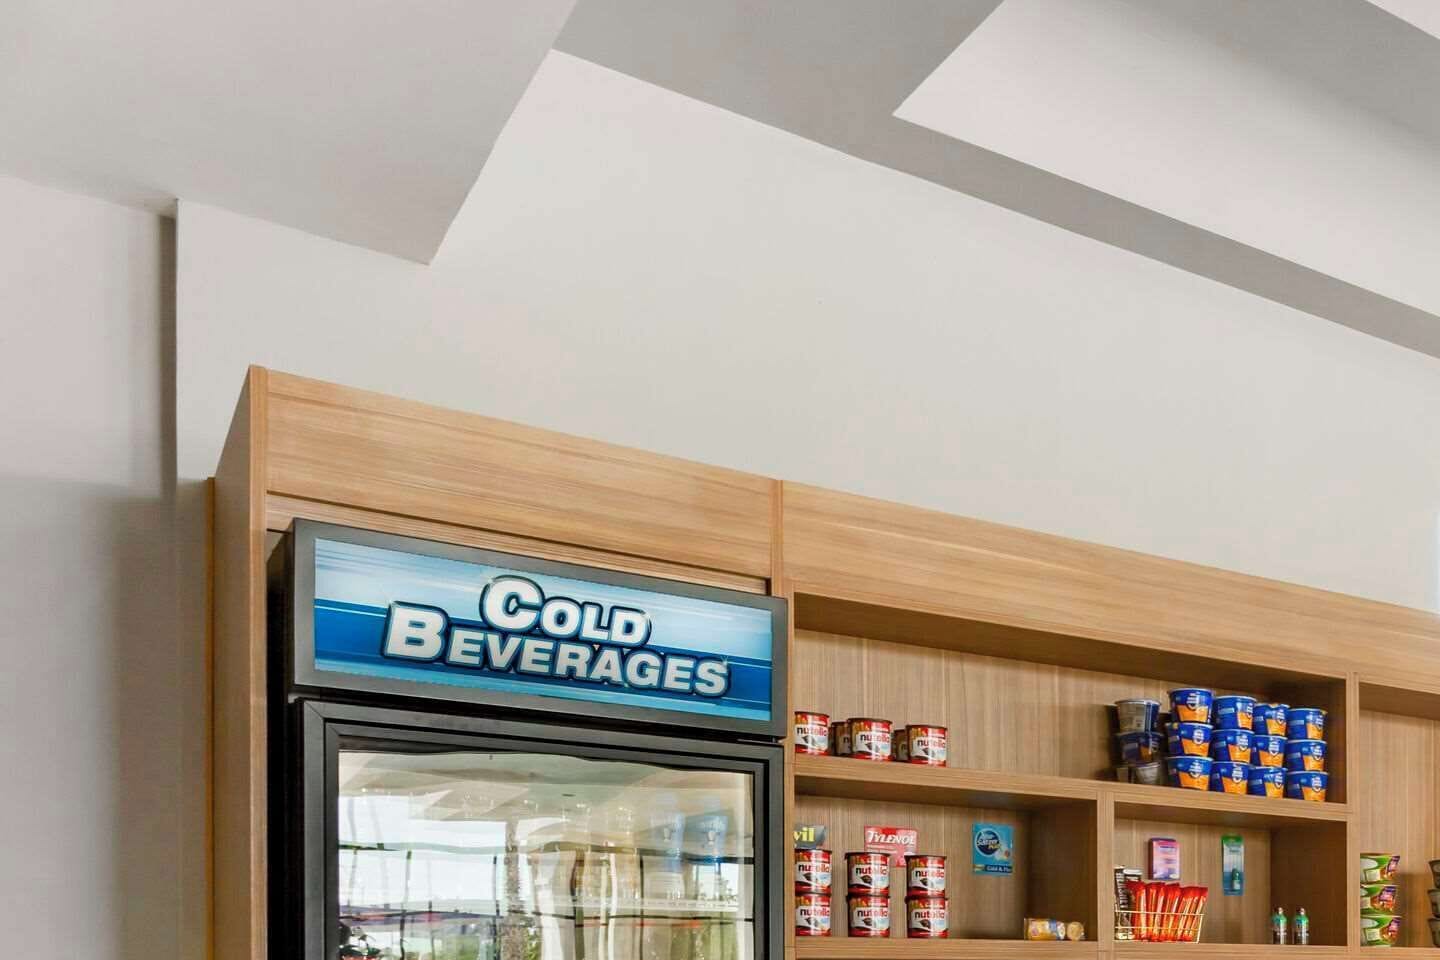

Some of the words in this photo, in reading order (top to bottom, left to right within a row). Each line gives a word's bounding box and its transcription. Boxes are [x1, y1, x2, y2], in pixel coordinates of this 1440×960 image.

[480, 575, 652, 647] COLD
[382, 602, 731, 698] BEVERAGES
[866, 830, 916, 846] TYLENOL
